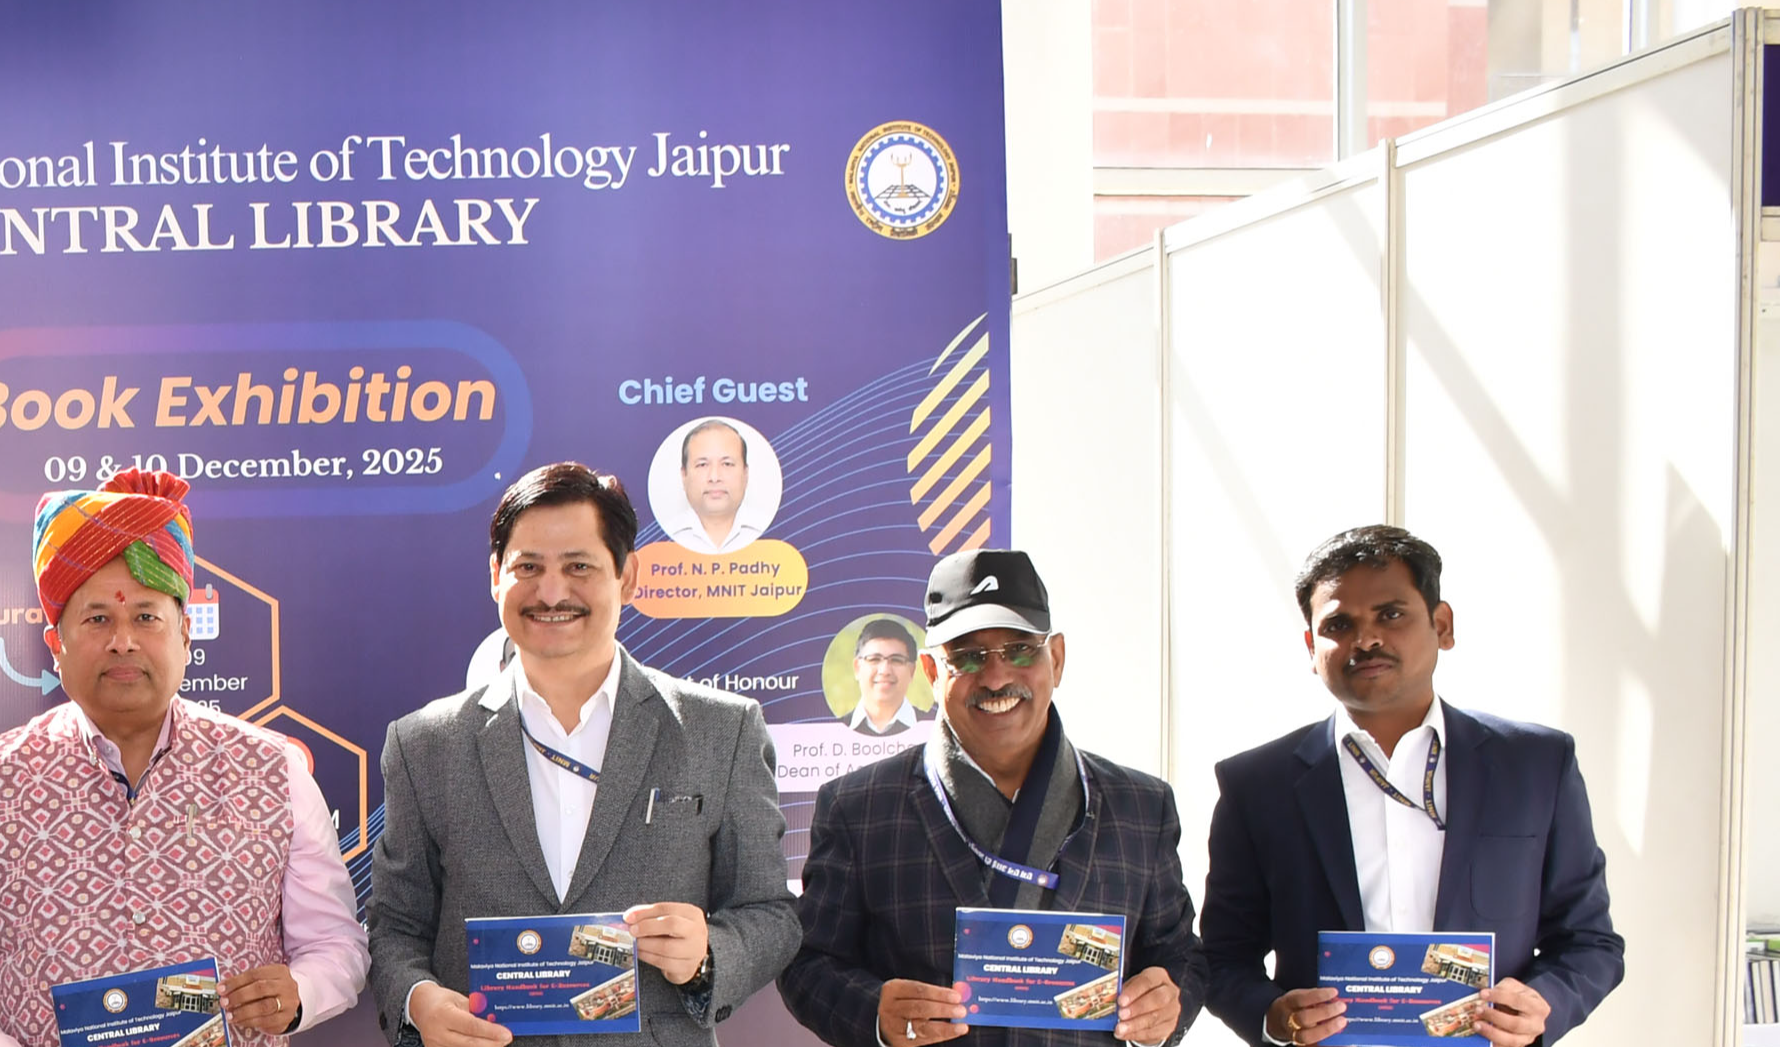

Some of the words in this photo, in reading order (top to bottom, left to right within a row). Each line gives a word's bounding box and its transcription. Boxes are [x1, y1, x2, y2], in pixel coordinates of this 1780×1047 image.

[110, 135, 298, 187] Institute
[309, 133, 362, 182] of
[362, 132, 637, 190] Technology
[648, 130, 790, 188] Jaipur
[250, 198, 540, 249] LIBRARY
[155, 366, 496, 428] Exhibition
[619, 379, 706, 406] Chief
[712, 377, 809, 406] Guest
[44, 456, 87, 482] 09
[96, 457, 122, 480] &
[178, 450, 352, 480] December,
[362, 447, 443, 475] 2025
[651, 562, 687, 576] Prof.
[692, 563, 707, 575] N.
[712, 562, 725, 575] P.
[729, 561, 780, 578] Padhy
[707, 584, 746, 597] MNIT
[750, 582, 802, 600] Jaipur
[725, 674, 799, 691] Honour
[793, 743, 827, 757] Prof.
[833, 743, 846, 756] D.
[778, 763, 820, 778] Dean
[825, 763, 840, 776] of
[496, 971, 534, 979] CENTRAL
[535, 970, 571, 978] LIBRARY
[984, 964, 1022, 973] CENTRAL
[1023, 966, 1058, 975] LIBRARY
[1346, 985, 1384, 993] CENTRAL
[1386, 986, 1422, 994] LIBRARY
[87, 1030, 125, 1042] CENTRAL
[126, 1023, 160, 1034] LIBRARY
